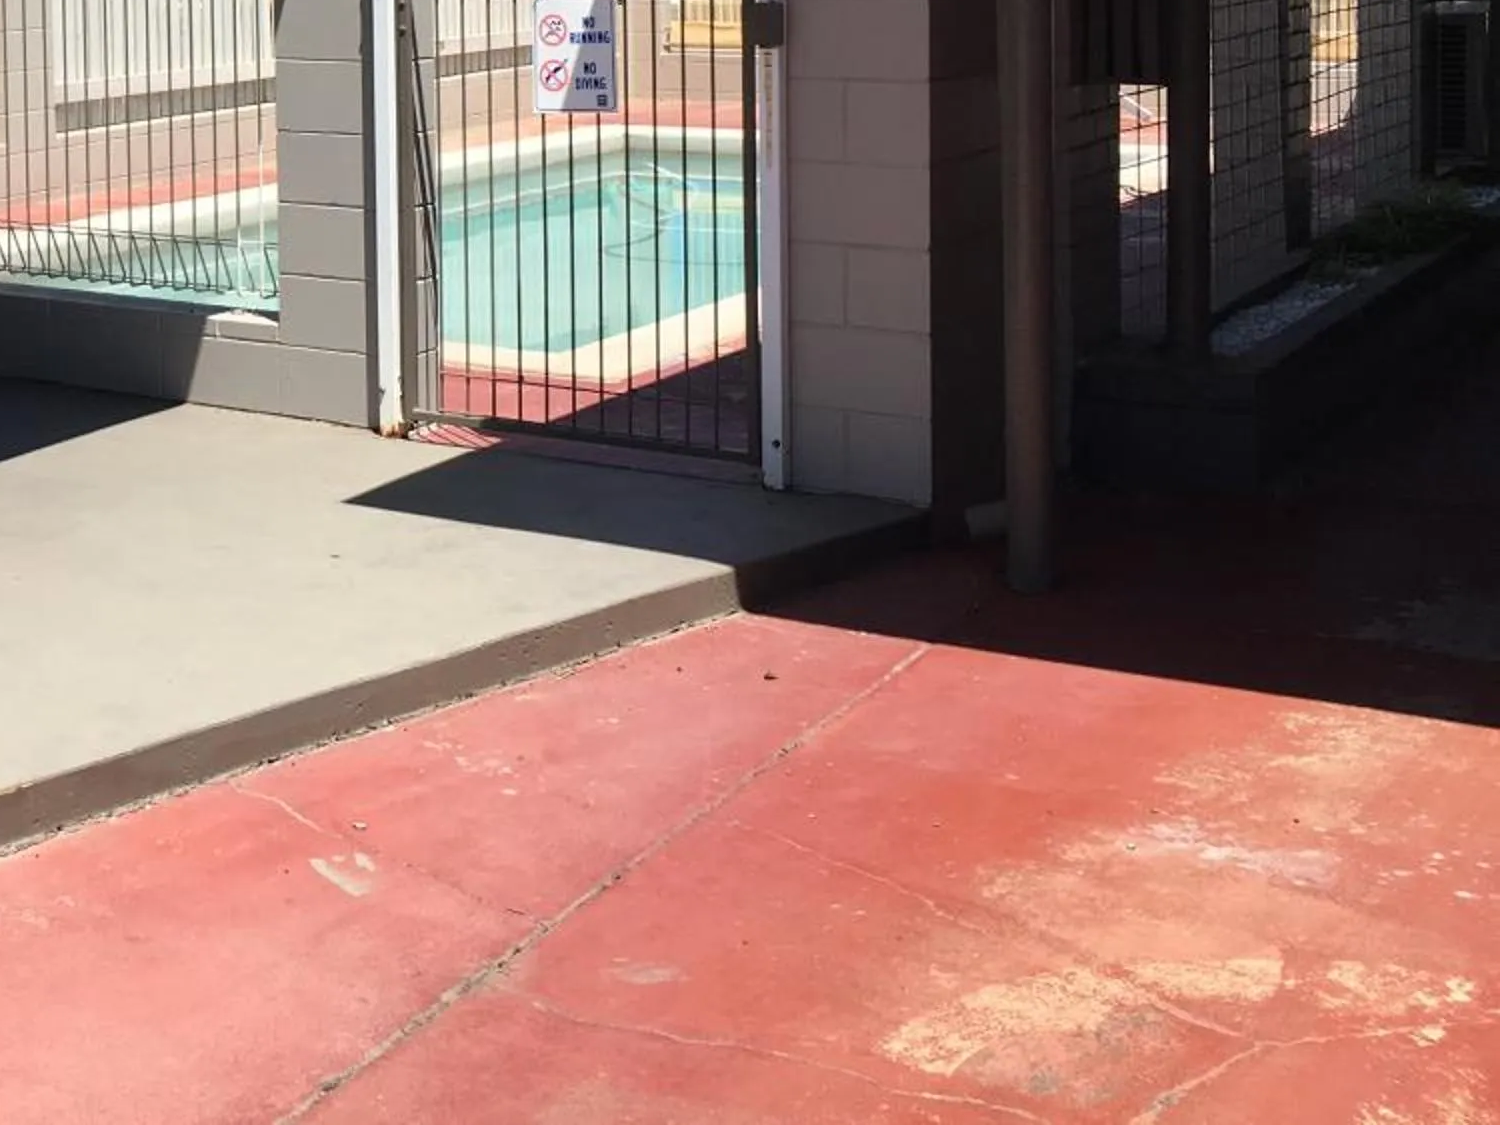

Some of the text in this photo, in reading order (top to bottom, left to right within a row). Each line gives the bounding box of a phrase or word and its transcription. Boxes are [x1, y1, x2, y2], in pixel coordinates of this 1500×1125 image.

[582, 16, 595, 29] NO
[583, 62, 597, 74] NO
[575, 77, 608, 90] DIVING
